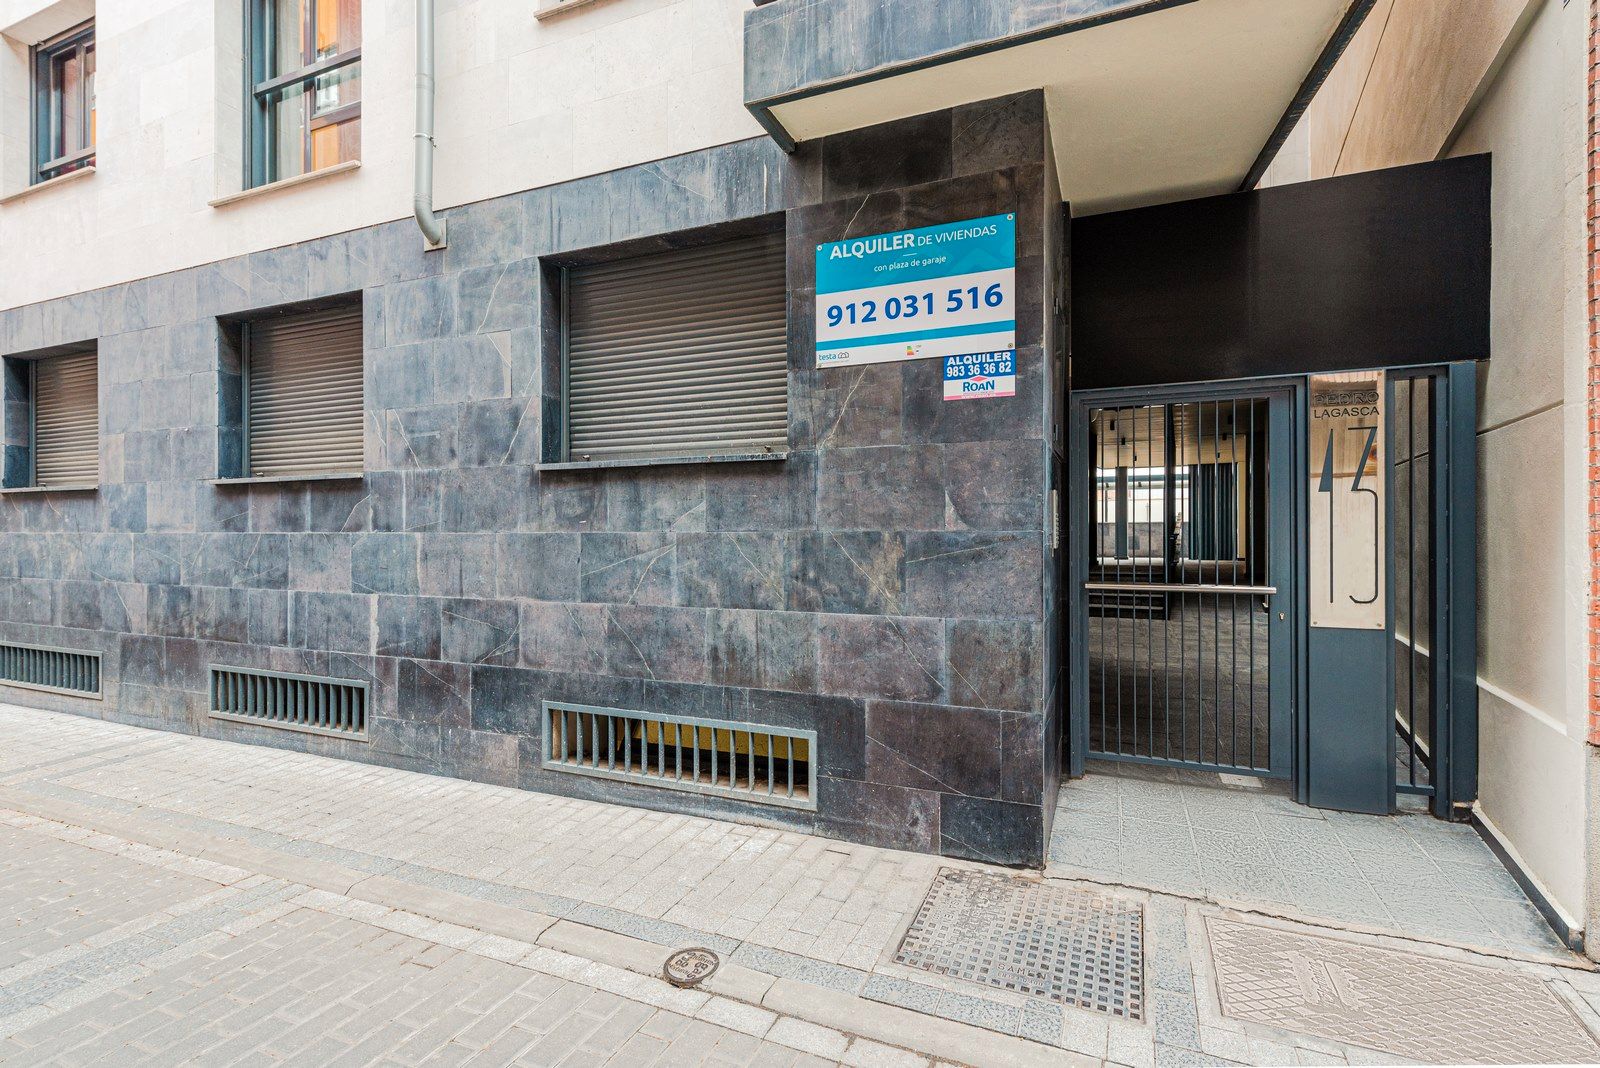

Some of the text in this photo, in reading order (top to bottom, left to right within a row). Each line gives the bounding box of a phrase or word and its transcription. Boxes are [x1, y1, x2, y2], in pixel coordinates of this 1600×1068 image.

[829, 224, 997, 260] ALQUILER DE VIVIENDAS
[874, 255, 946, 272] con plaza de garaje
[827, 283, 1004, 327] 912 031 516
[818, 353, 837, 361] testa
[947, 351, 1011, 366] ALQUILER
[946, 361, 1012, 377] 983 36 36 82
[963, 380, 995, 392] ROAN
[1313, 391, 1380, 407] PEDRO
[1313, 406, 1380, 419] LAGASCA
[1318, 426, 1379, 604] 13
